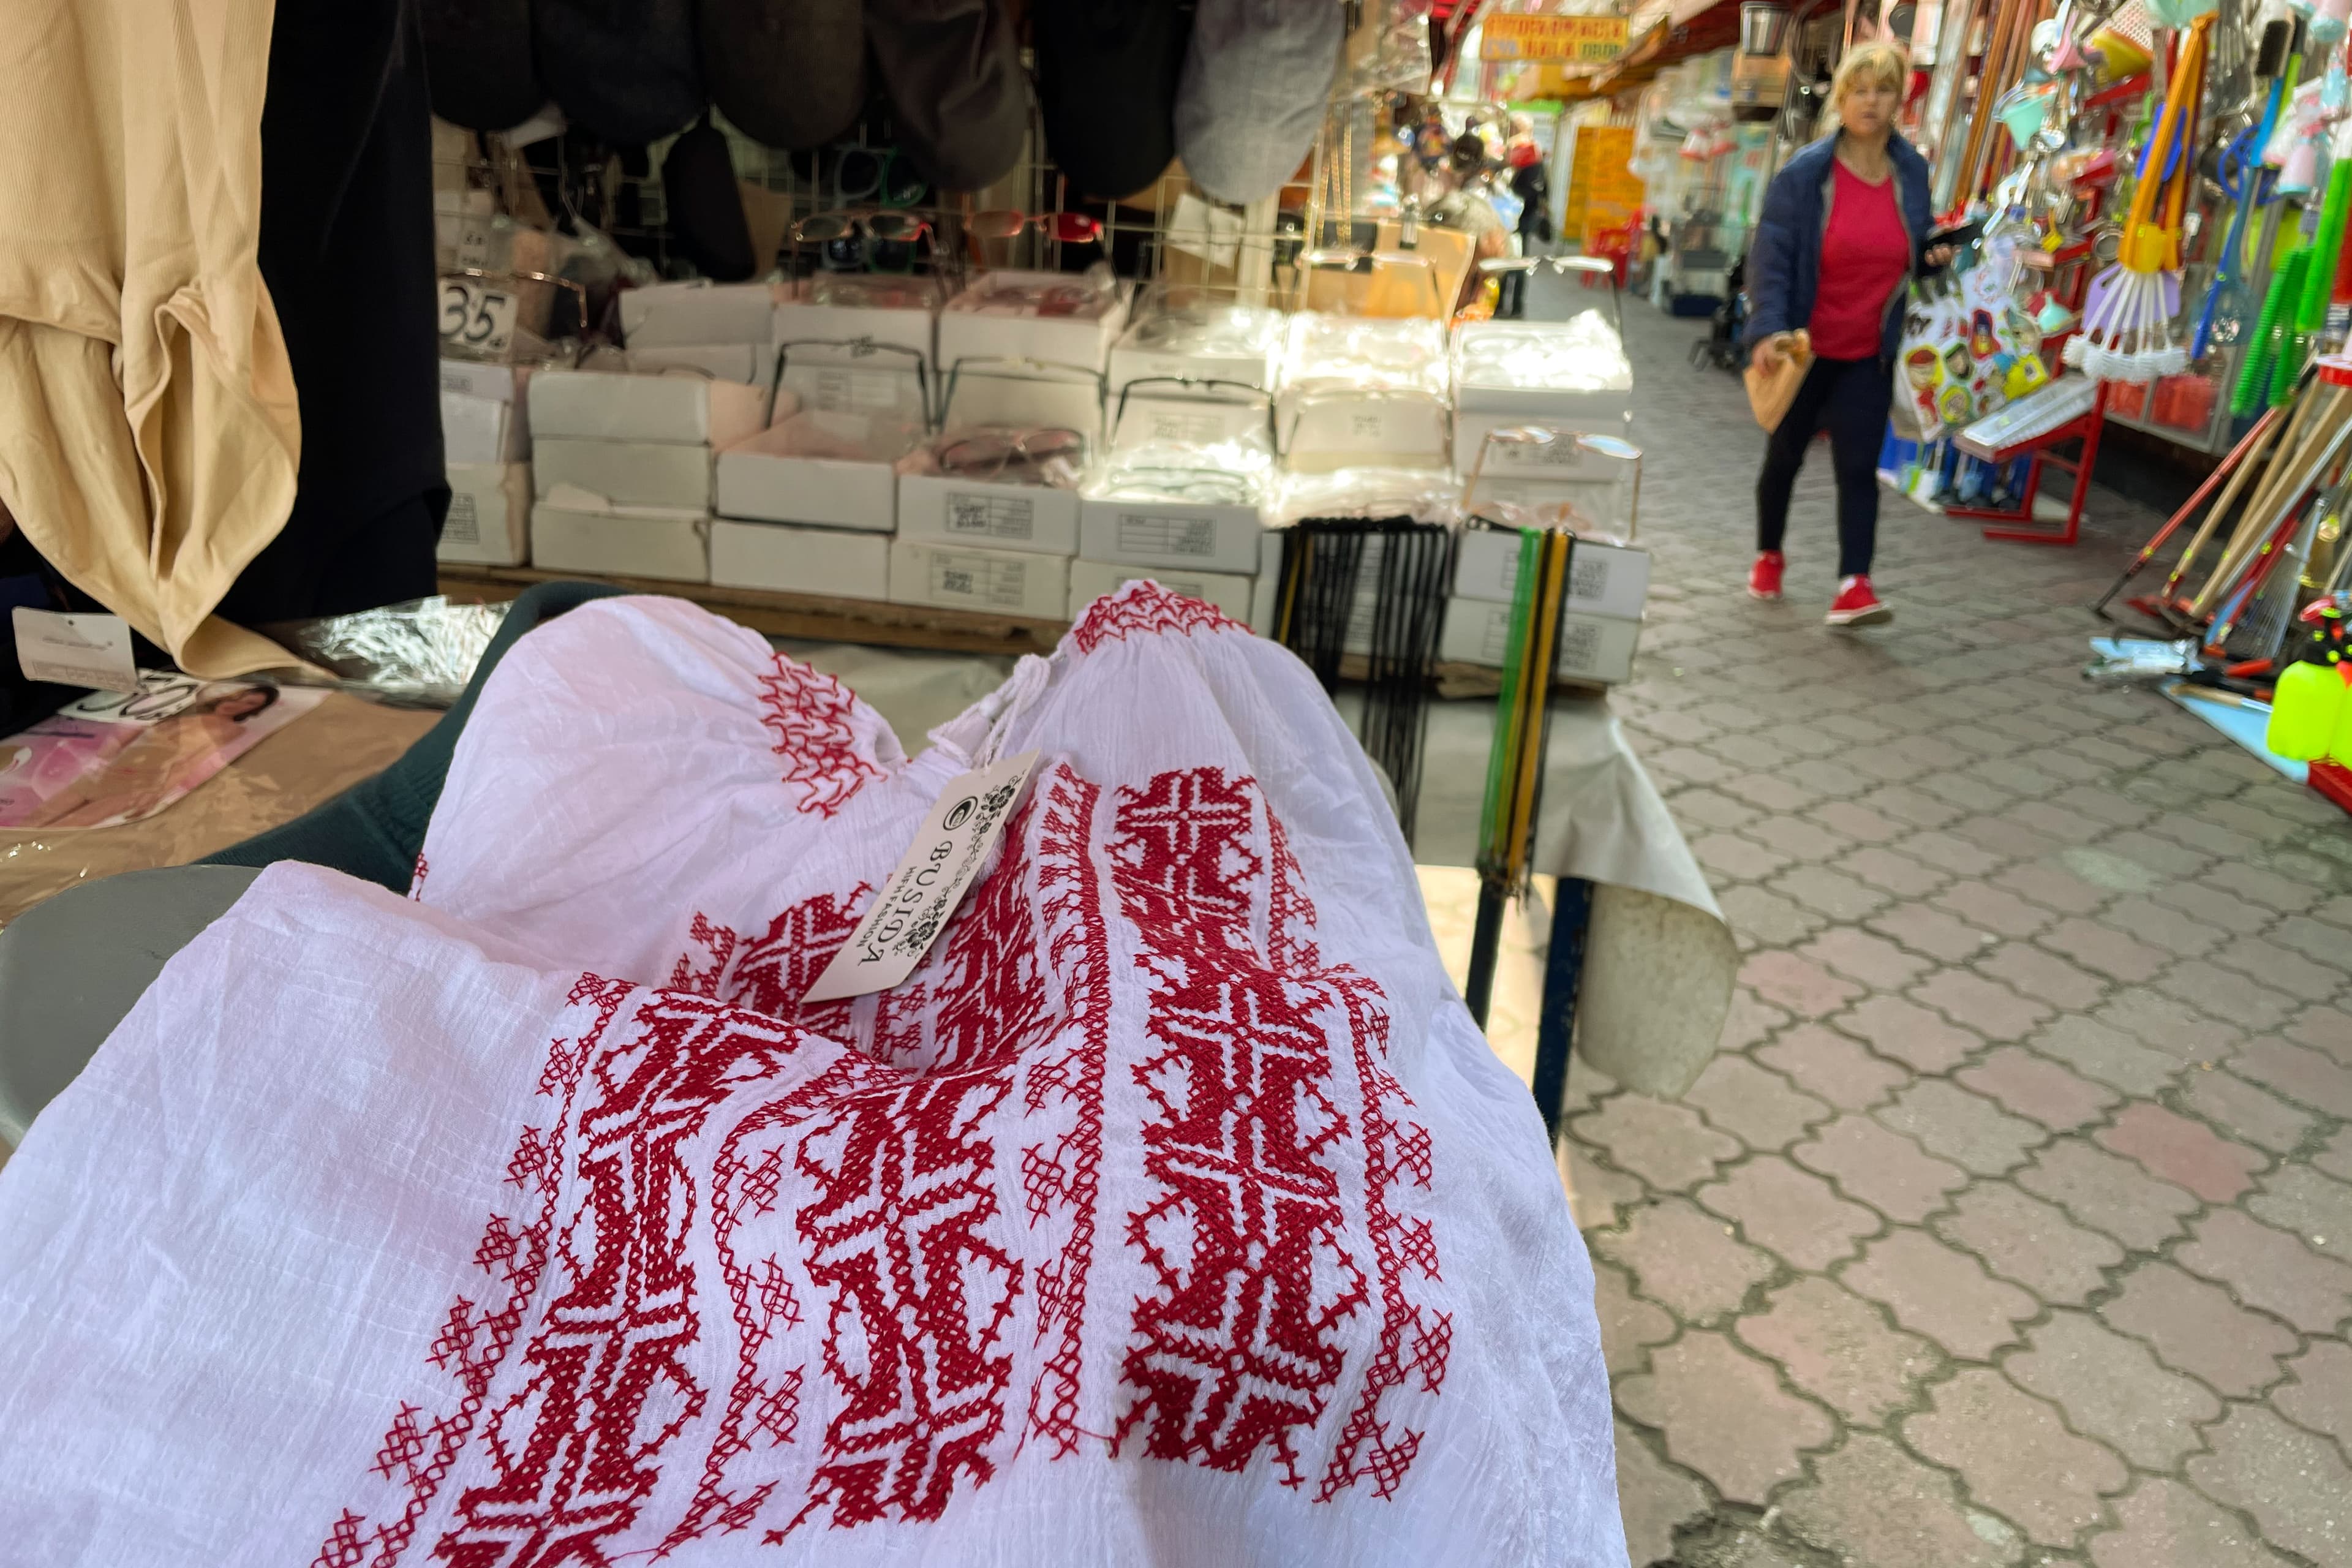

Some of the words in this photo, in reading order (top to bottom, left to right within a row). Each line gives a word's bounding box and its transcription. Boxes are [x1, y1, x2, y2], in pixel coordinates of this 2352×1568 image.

[439, 285, 505, 341] 35
[856, 896, 898, 948] FASHION
[858, 841, 953, 967] BUSIDA
